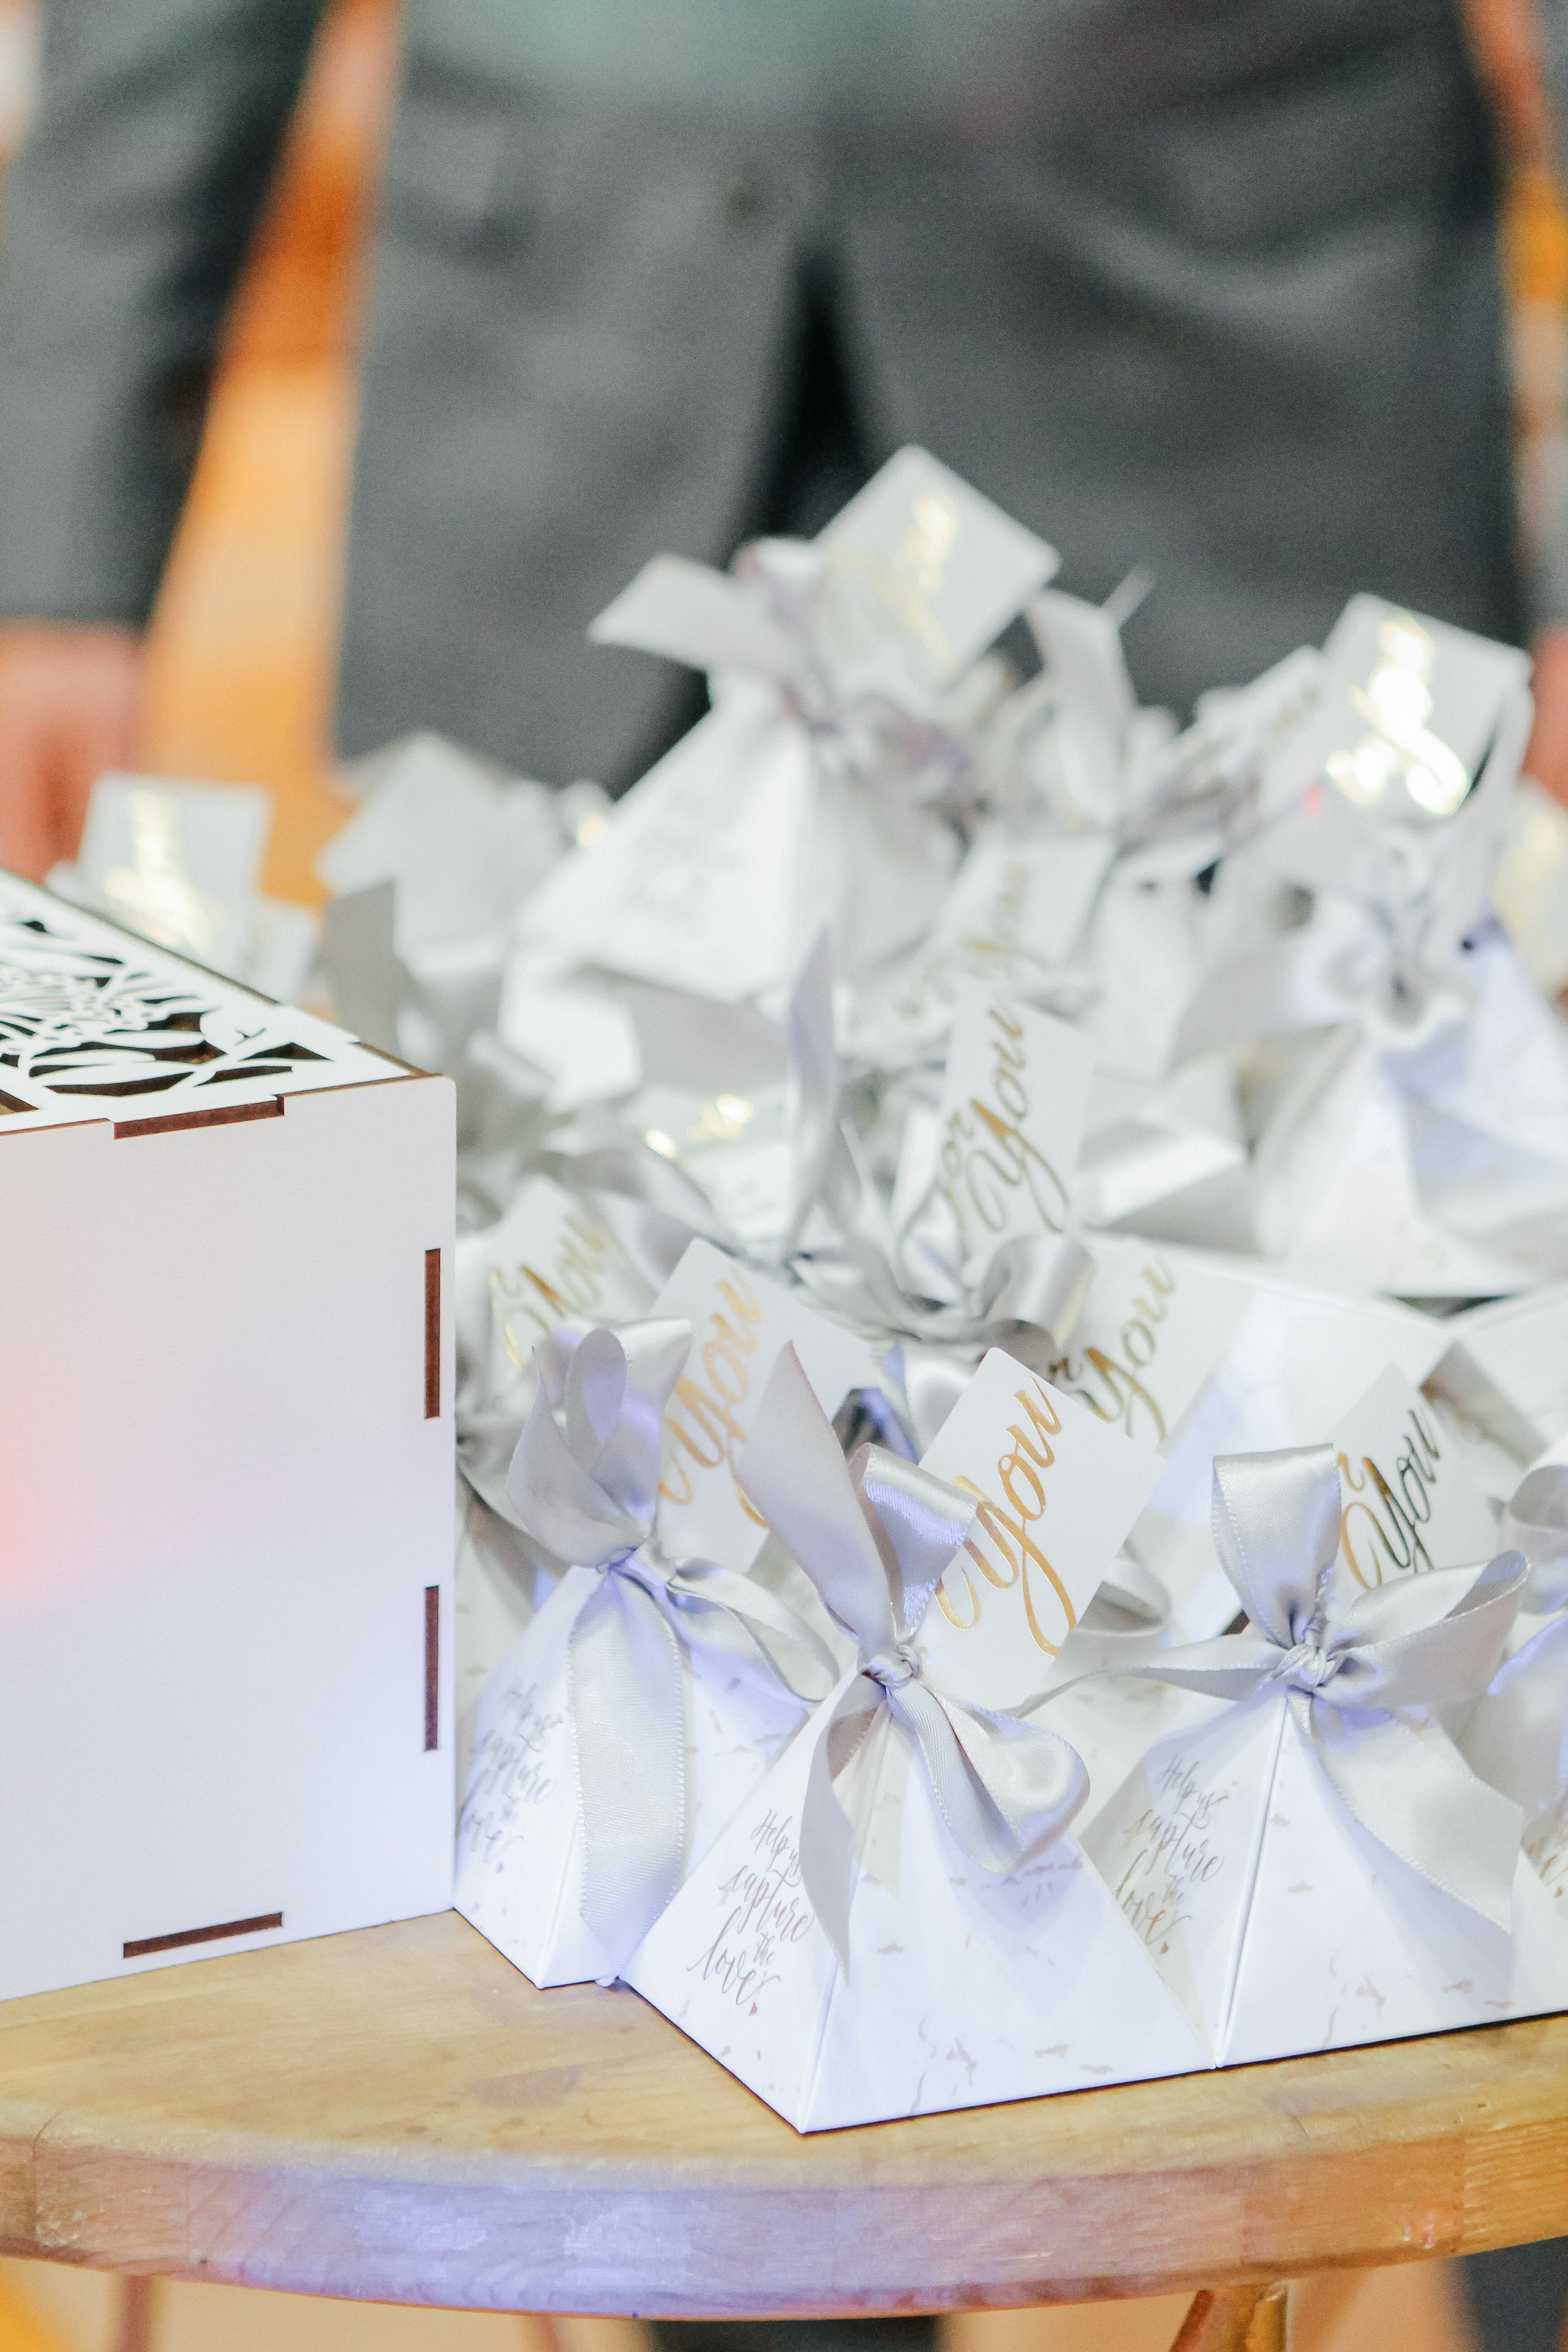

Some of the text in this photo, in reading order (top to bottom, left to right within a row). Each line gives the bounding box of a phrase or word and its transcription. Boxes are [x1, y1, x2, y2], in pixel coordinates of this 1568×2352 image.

[965, 993, 1071, 1234] You
[935, 1376, 1061, 1657] You
[1340, 1405, 1441, 1591] You
[1154, 1754, 1229, 1822] Help us
[750, 1808, 793, 1872] Help
[1121, 1808, 1224, 1883] capture
[718, 1864, 816, 1943] capture
[1162, 1874, 1185, 1907] the
[753, 1932, 775, 1967] the
